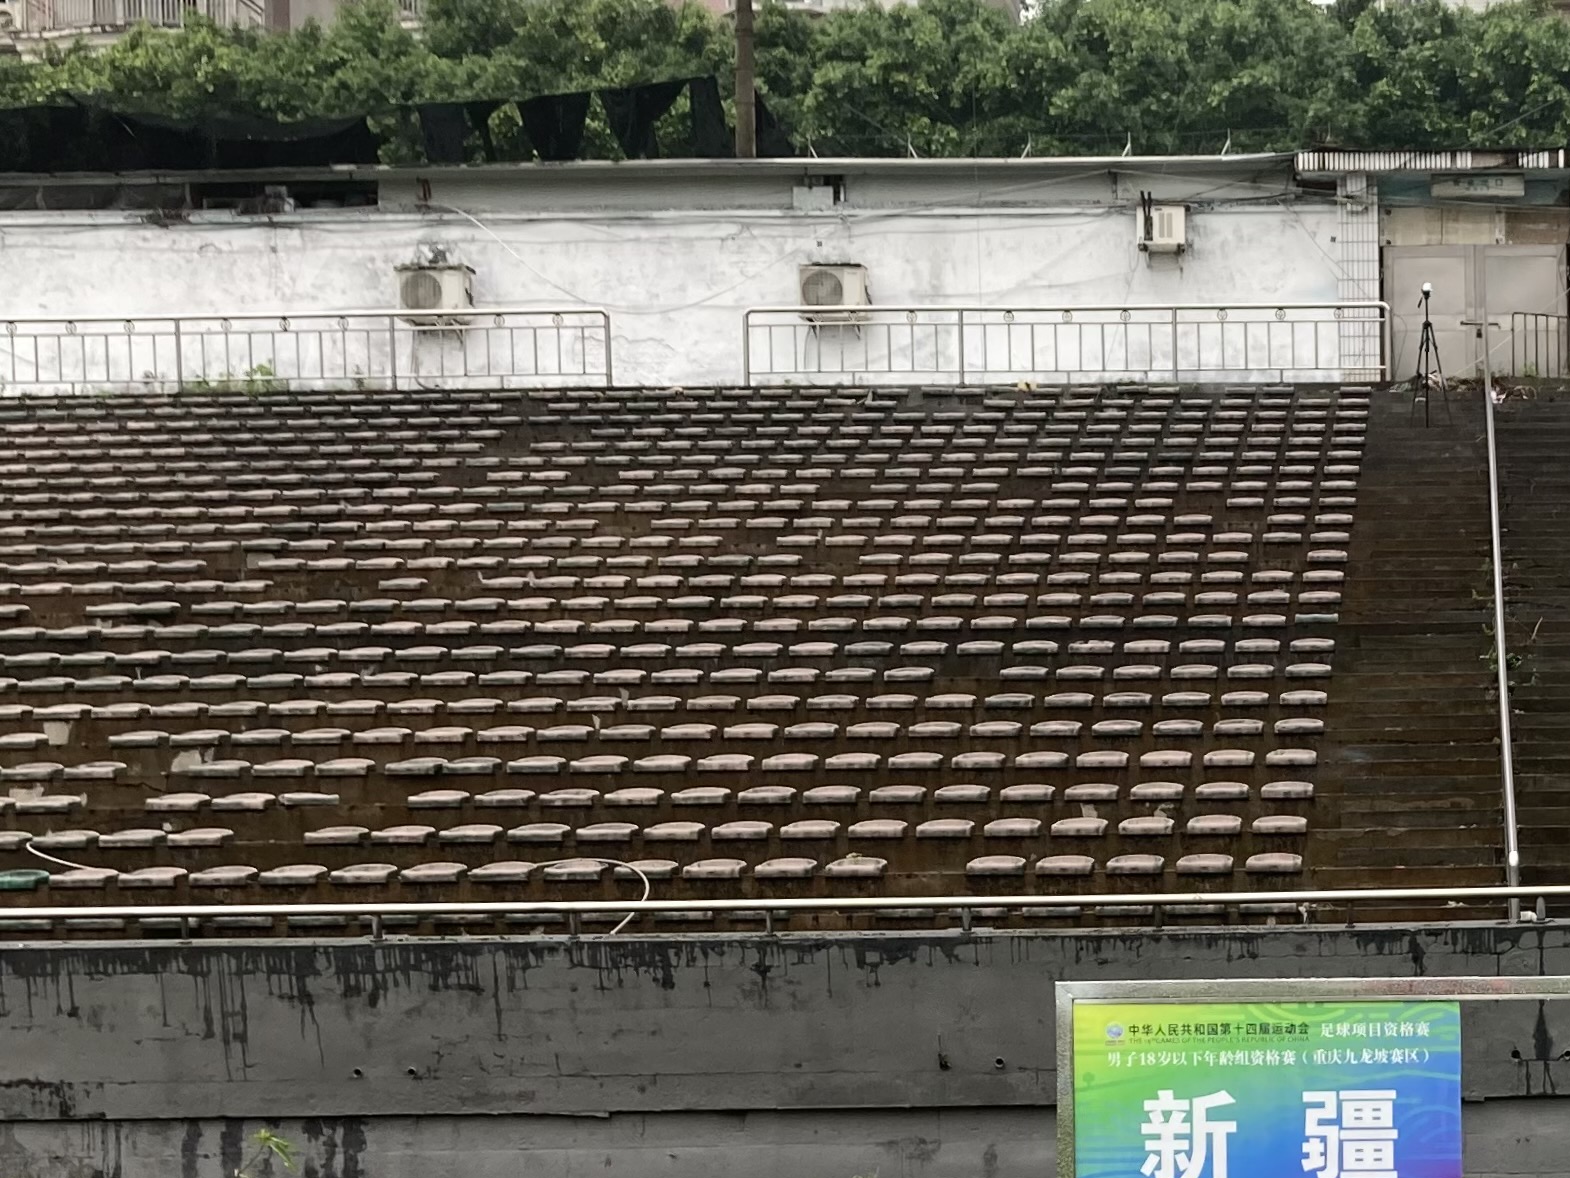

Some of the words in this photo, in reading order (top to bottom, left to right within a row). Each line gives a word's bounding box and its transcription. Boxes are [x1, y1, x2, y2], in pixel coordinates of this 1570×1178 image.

[1128, 1022, 1310, 1036] 中华人民共和国第十四届运动会
[1320, 1021, 1431, 1037] 足球项目资格赛
